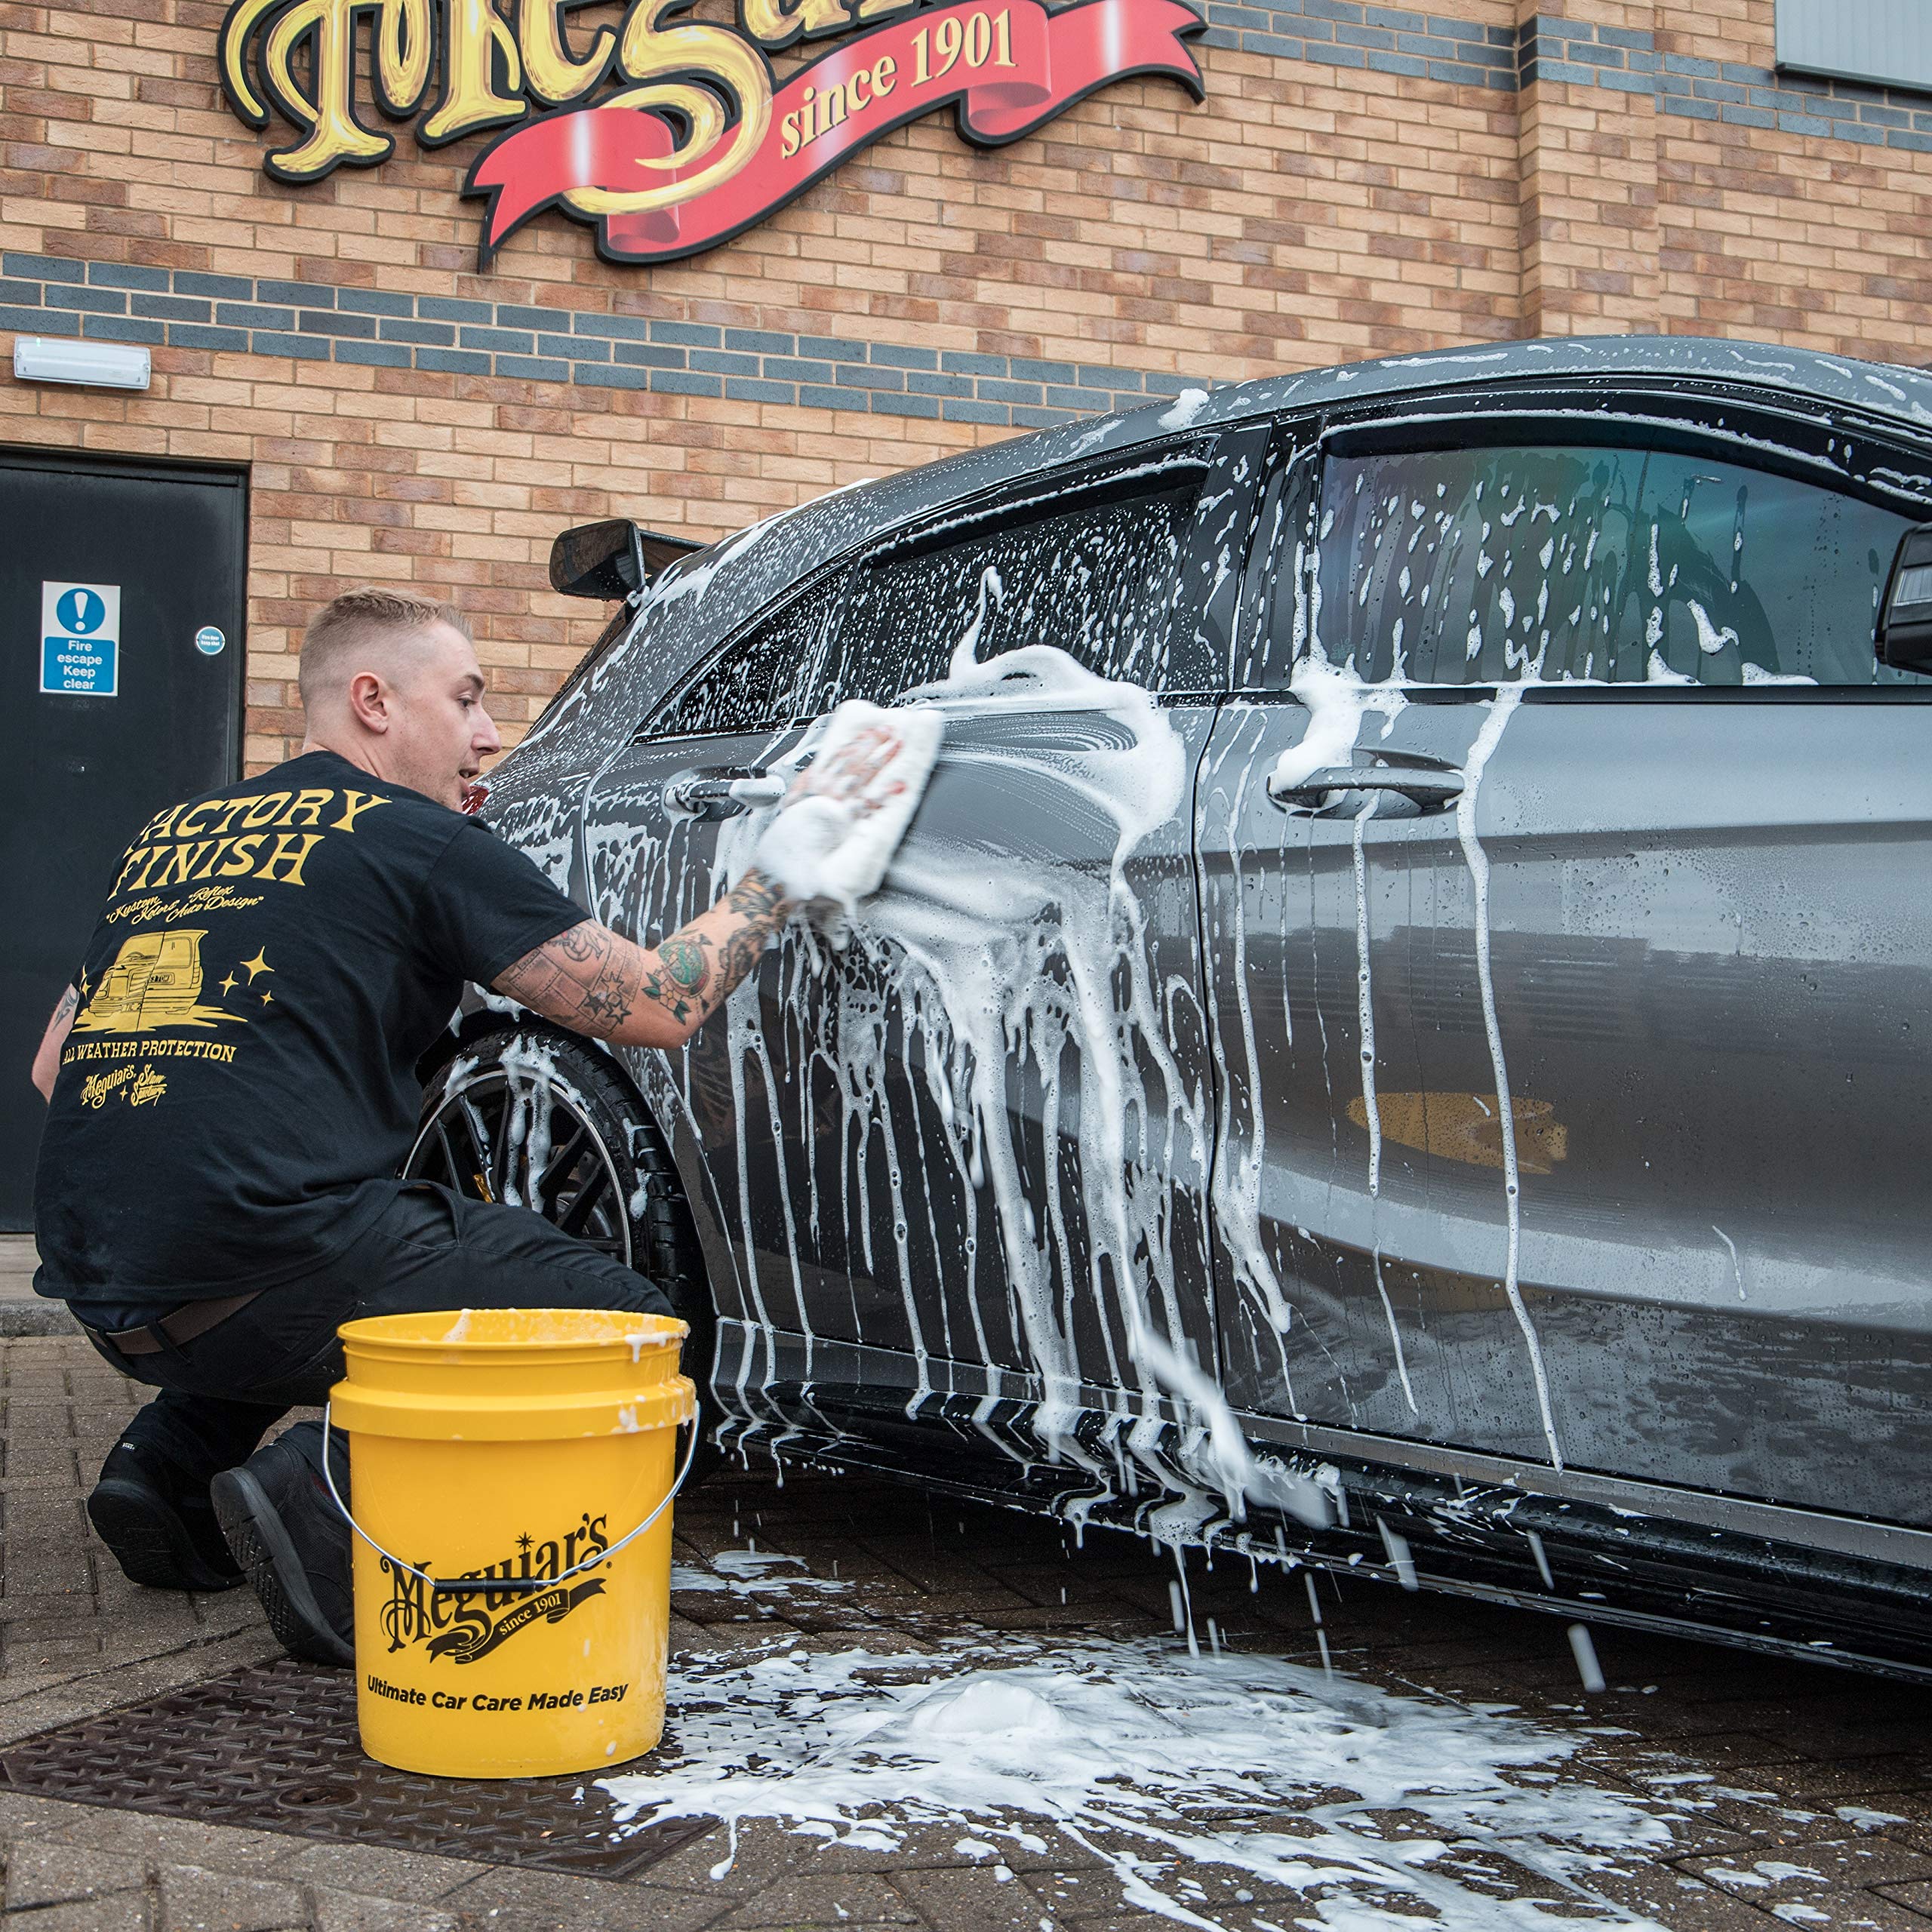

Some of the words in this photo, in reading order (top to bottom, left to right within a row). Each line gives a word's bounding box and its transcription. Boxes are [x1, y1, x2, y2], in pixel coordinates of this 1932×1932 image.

[780, 57, 898, 160] since
[910, 10, 1018, 88] 1901
[68, 640, 92, 651] Fire
[57, 654, 103, 666] escape
[63, 665, 96, 679] Keep
[63, 678, 95, 690] clear
[107, 833, 325, 902] FINISH
[77, 1041, 137, 1060] WEATHER
[139, 1039, 238, 1063] PROTECTION
[499, 1608, 533, 1635] since
[534, 1592, 561, 1614] 1901
[368, 1675, 426, 1706] Ultimate
[432, 1691, 467, 1709] Car
[472, 1694, 522, 1711] Care
[528, 1690, 583, 1711] Made
[588, 1682, 629, 1705] Easy
